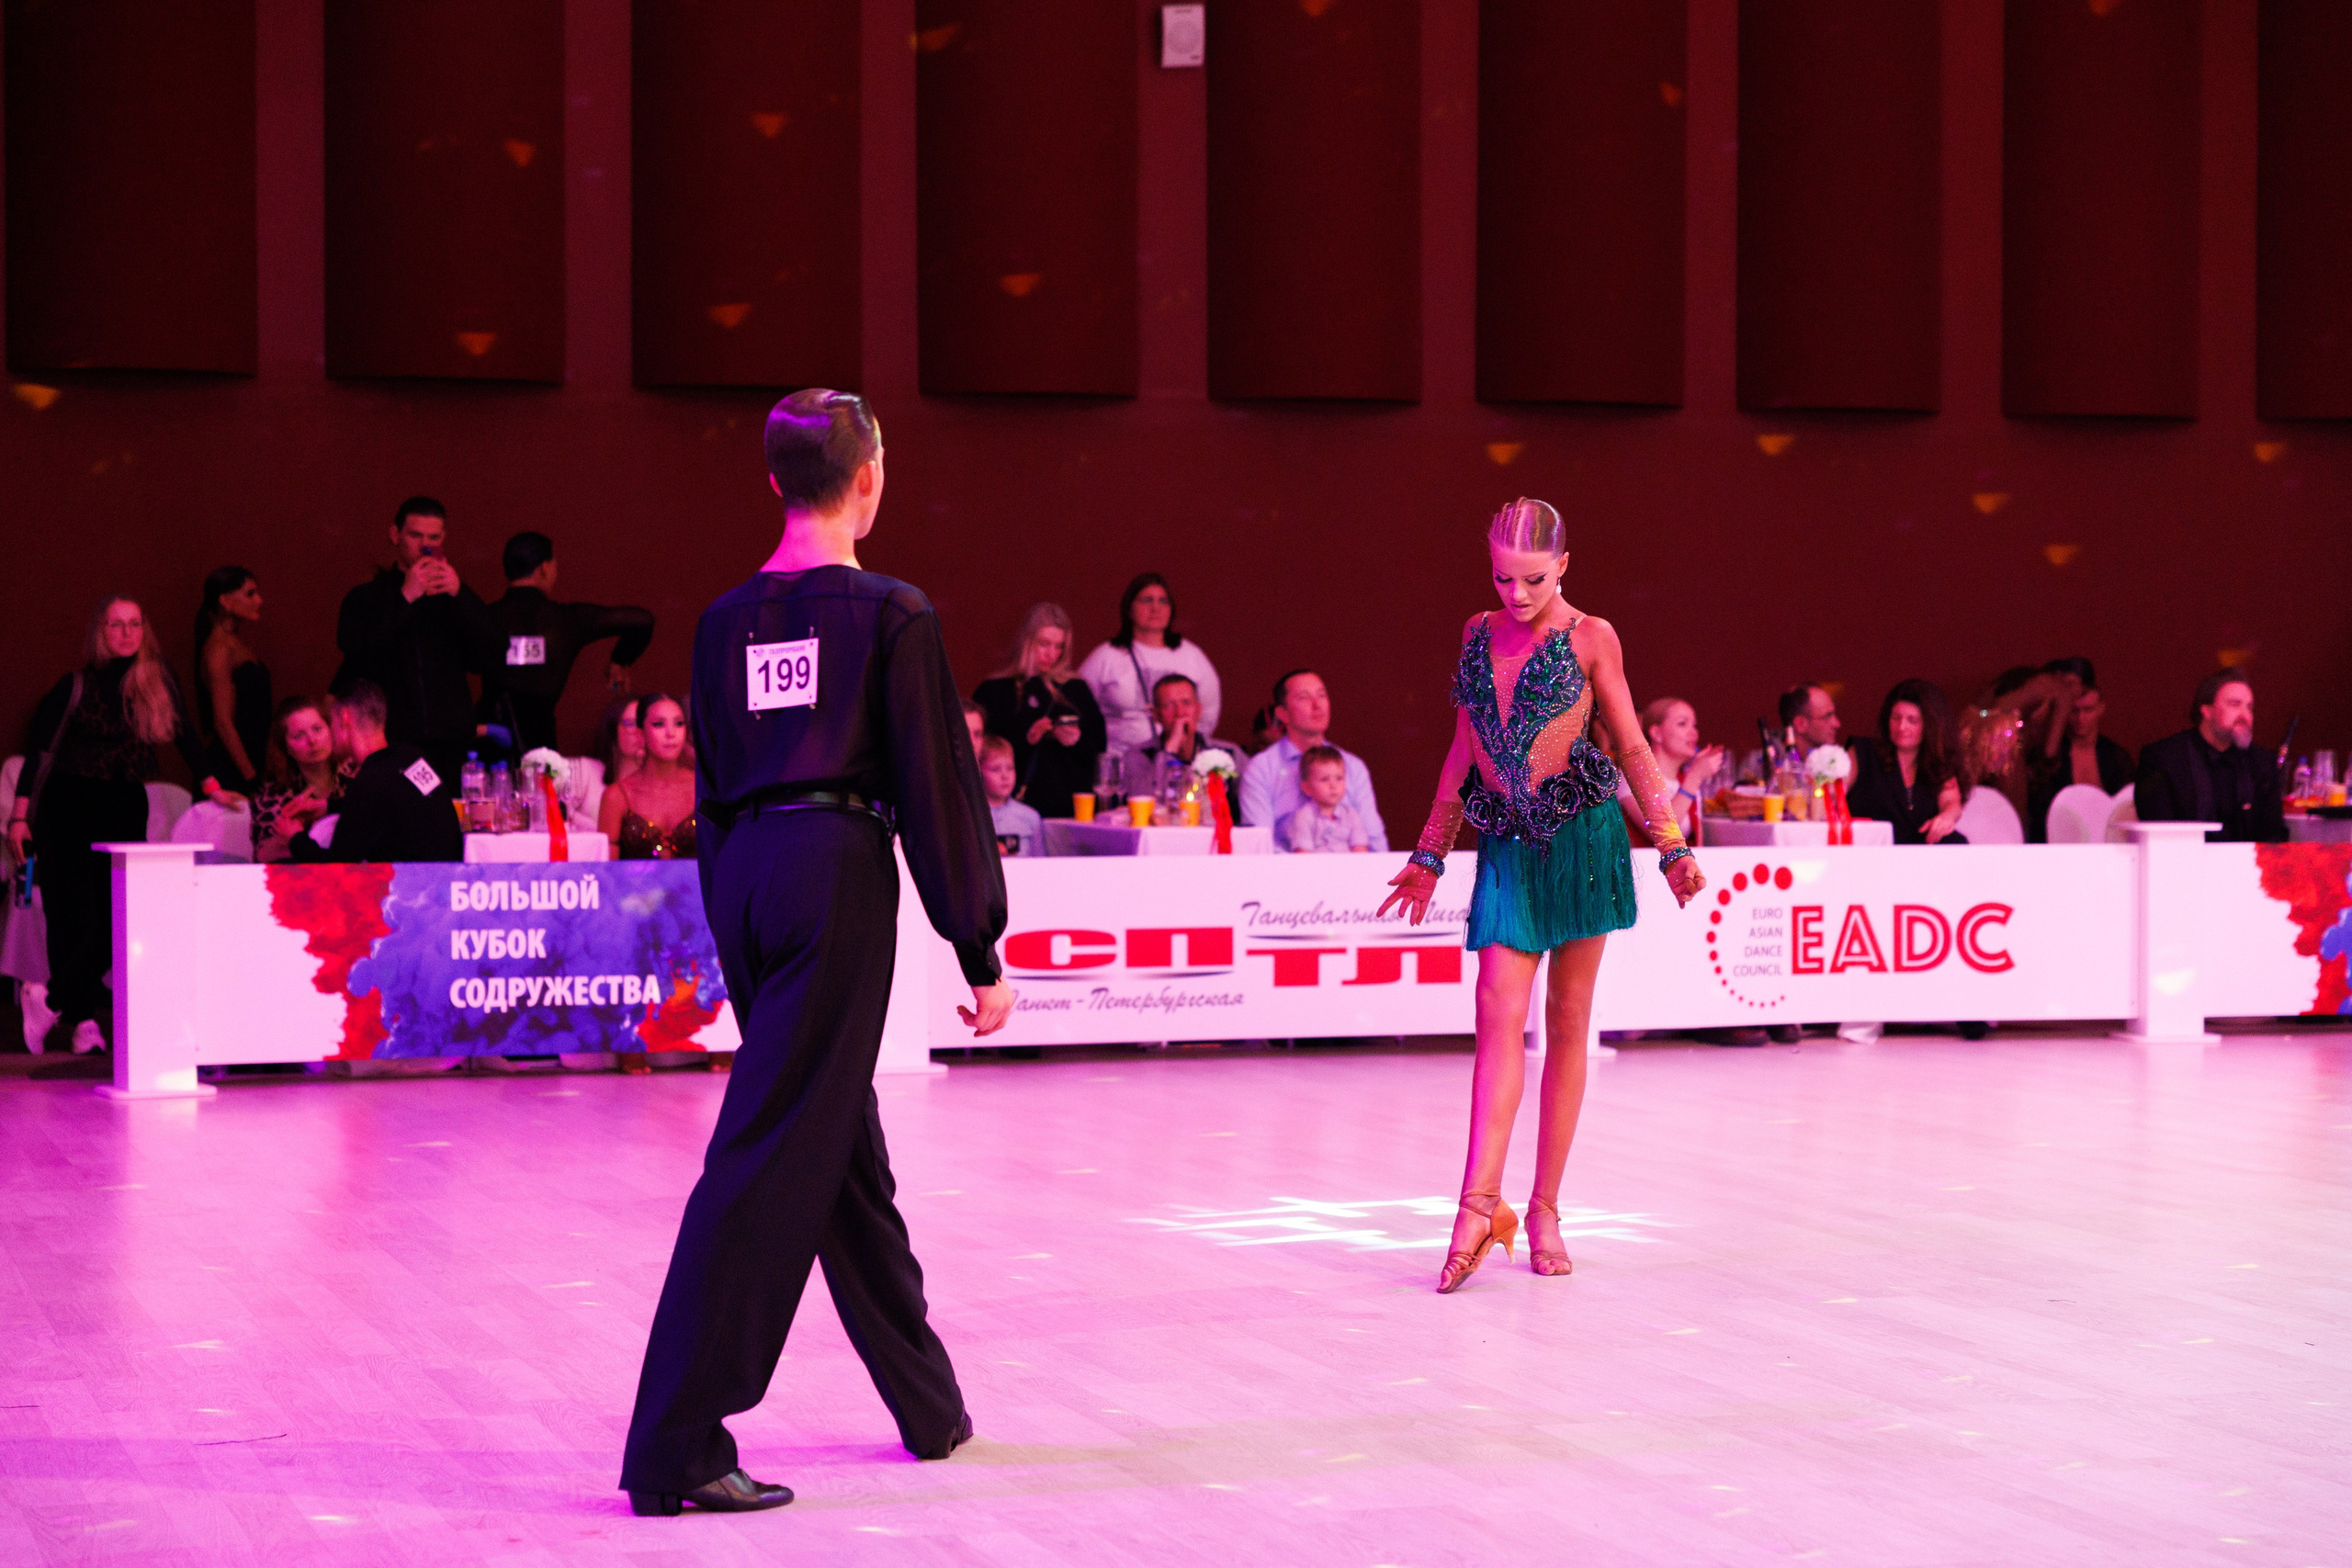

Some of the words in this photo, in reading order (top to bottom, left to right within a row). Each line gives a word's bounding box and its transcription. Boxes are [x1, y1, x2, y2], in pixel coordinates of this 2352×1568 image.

[758, 656, 810, 694] 199
[450, 874, 600, 912] БОЛЬШОЙ
[1752, 908, 1783, 919] EURO
[450, 928, 547, 960] КУБОК
[1004, 927, 1234, 970] СП
[1744, 946, 1783, 958] DANCE
[1748, 927, 1783, 939] ASIAN
[1792, 902, 2017, 975] EADC
[1246, 945, 1463, 987] ТЛ
[1733, 964, 1783, 977] COUNCIL
[449, 974, 662, 1013] СОДРУЖЕСТВА
